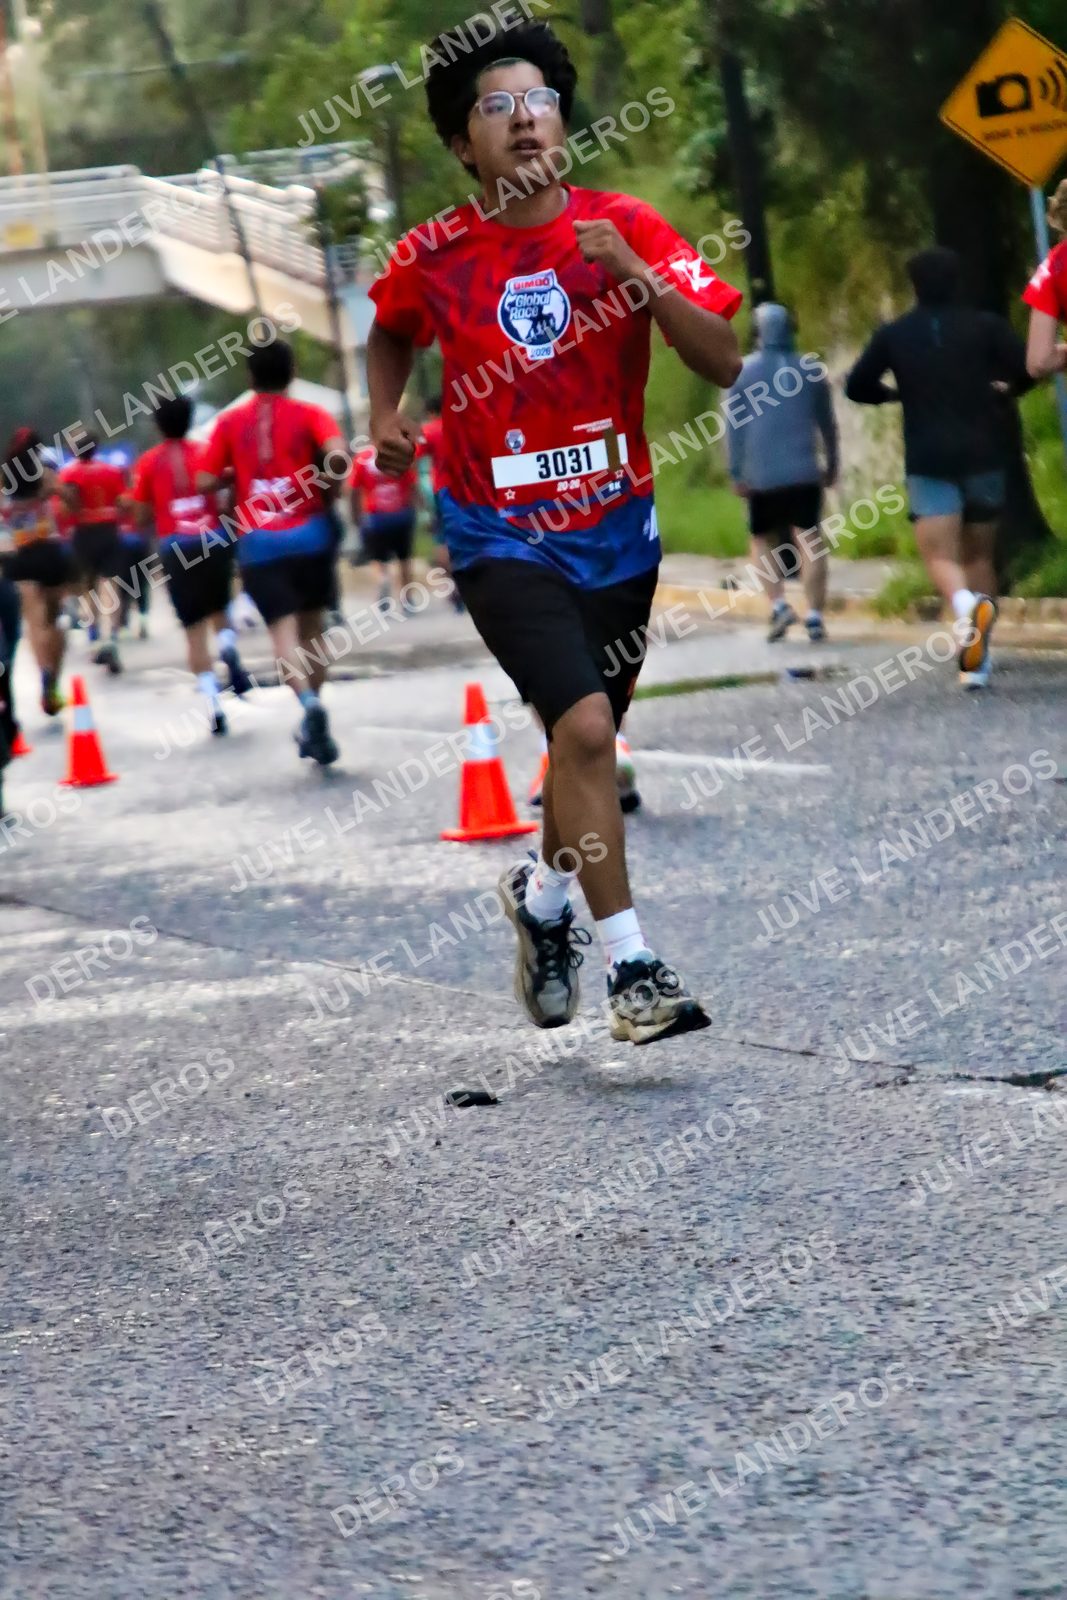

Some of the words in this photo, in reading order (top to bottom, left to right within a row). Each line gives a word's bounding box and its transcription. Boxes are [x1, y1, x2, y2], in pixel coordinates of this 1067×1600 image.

[516, 291, 550, 307] Global
[510, 307, 539, 319] Race
[536, 445, 592, 479] 3031
